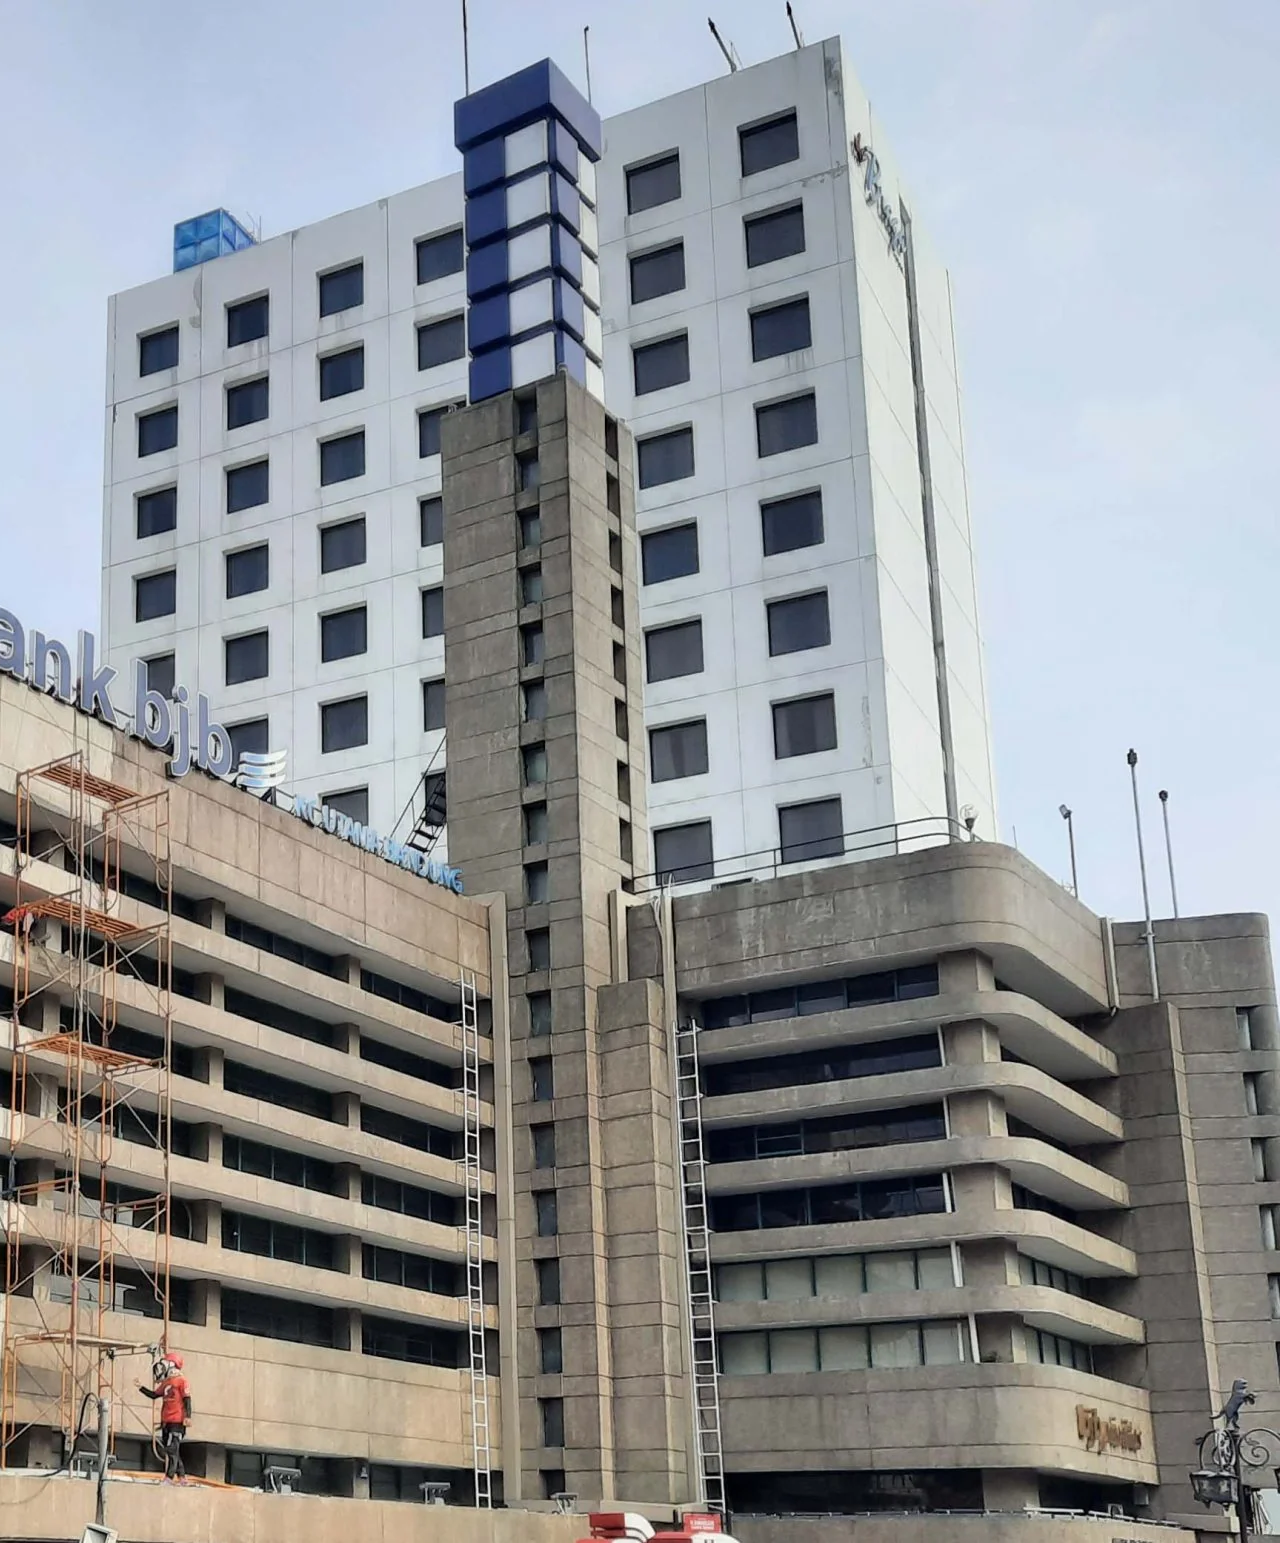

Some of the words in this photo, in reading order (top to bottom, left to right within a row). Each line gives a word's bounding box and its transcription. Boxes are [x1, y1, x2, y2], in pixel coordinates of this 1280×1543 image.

[129, 657, 233, 778] bjb
[321, 804, 381, 854] UTAMA
[383, 836, 464, 894] BANDUNG
